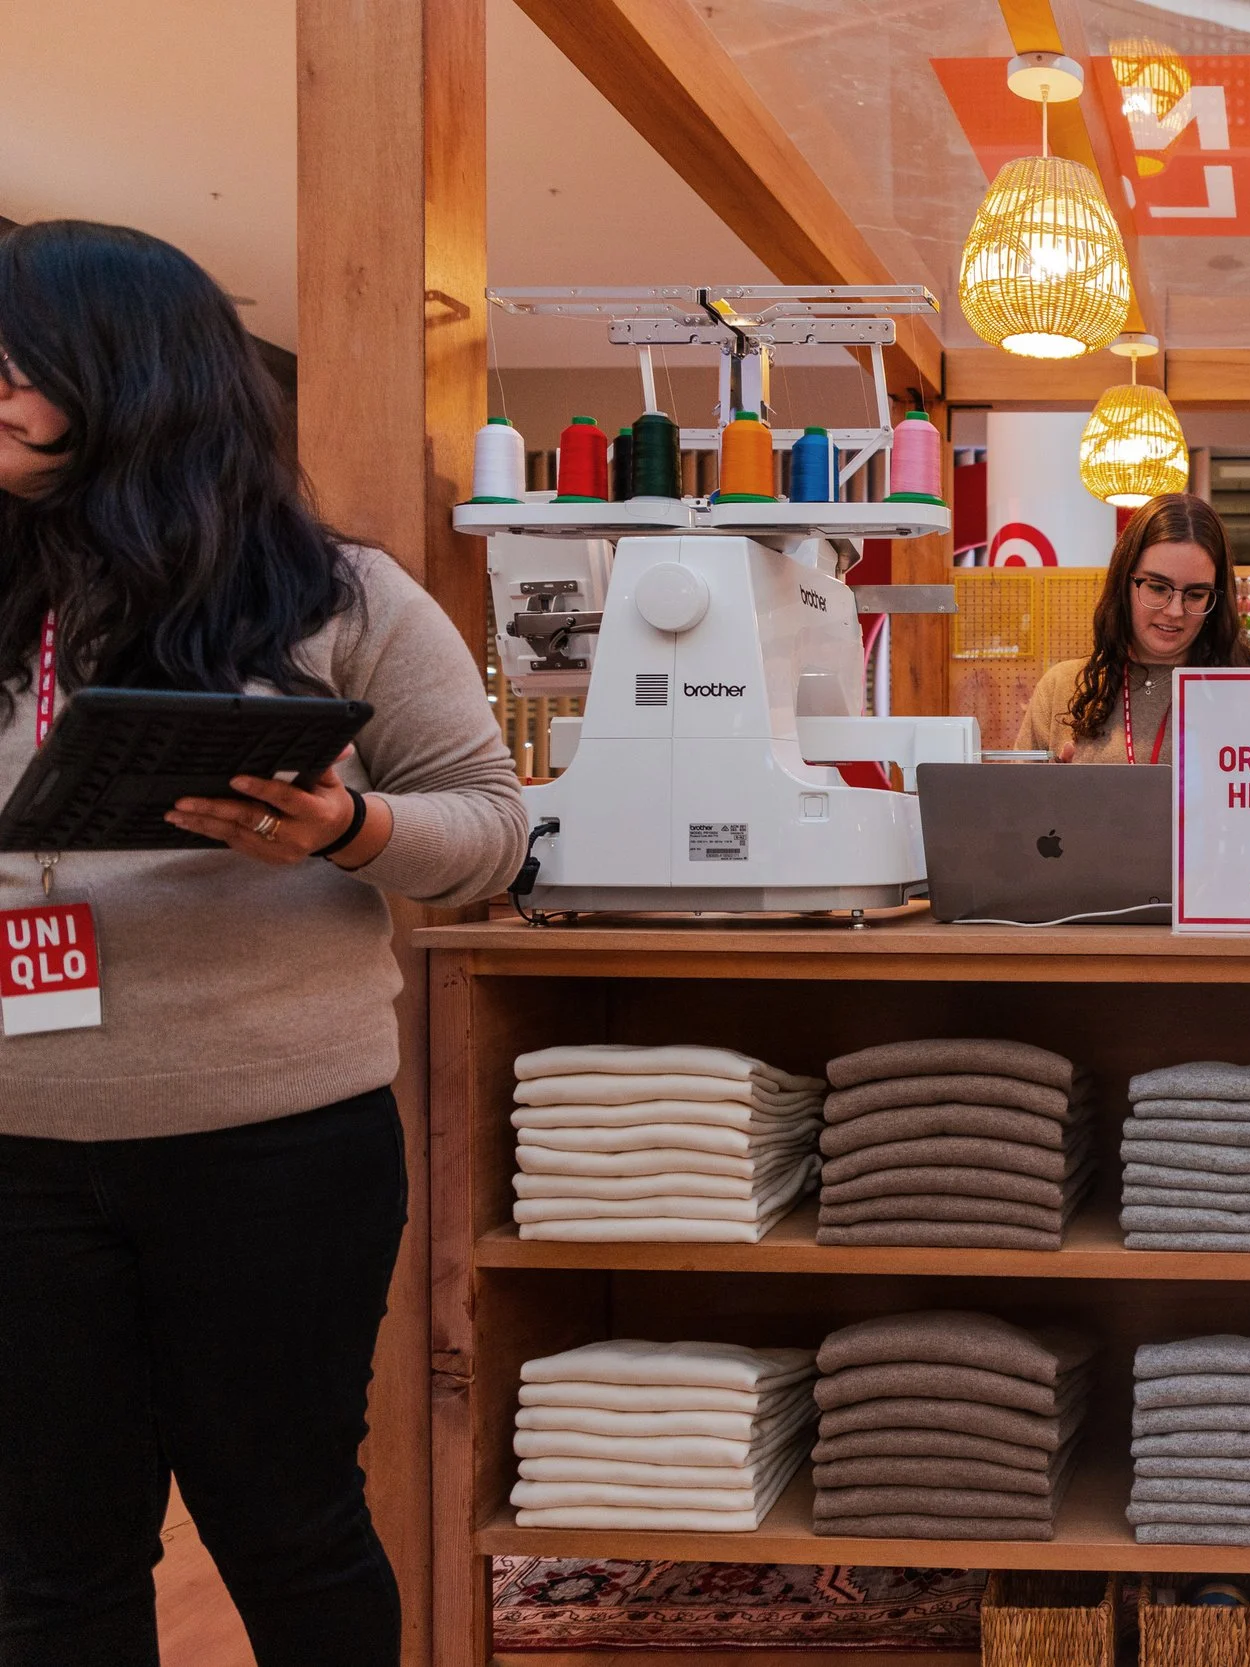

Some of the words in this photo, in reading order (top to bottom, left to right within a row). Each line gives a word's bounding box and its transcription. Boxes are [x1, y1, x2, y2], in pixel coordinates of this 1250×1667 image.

[799, 584, 827, 612] brother
[684, 682, 746, 697] brother
[6, 914, 77, 950] UNI
[10, 949, 87, 990] QLO
